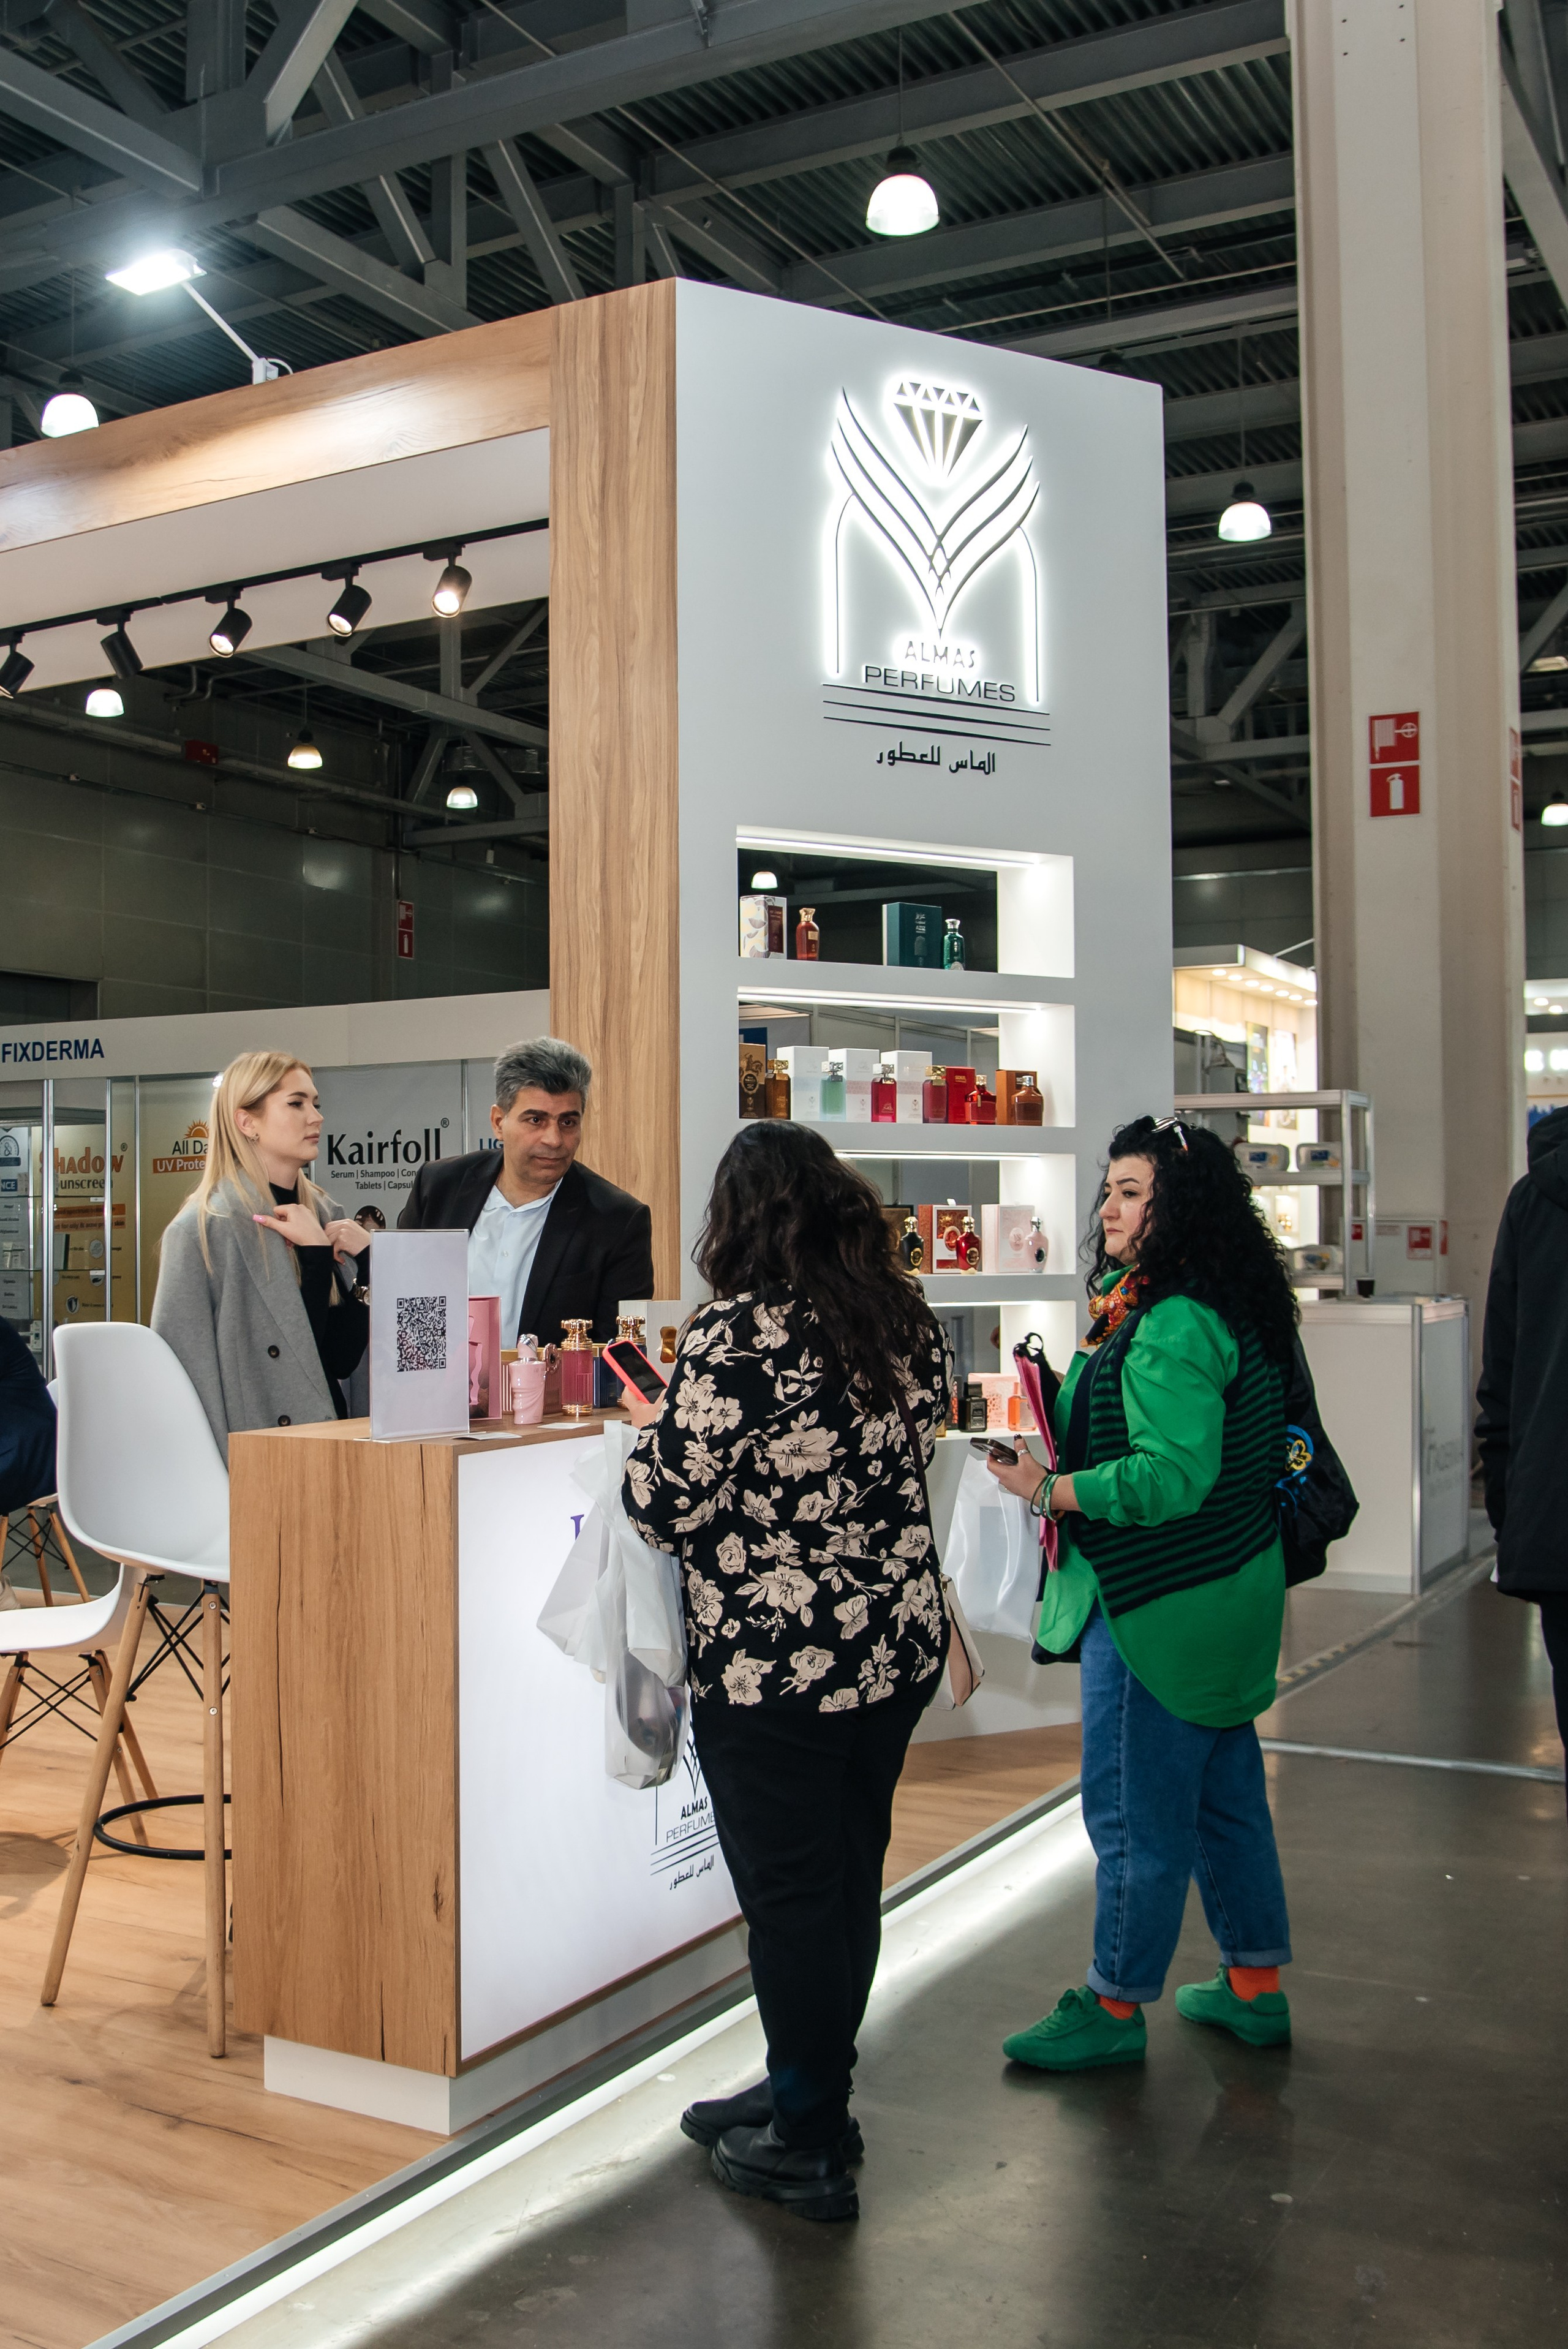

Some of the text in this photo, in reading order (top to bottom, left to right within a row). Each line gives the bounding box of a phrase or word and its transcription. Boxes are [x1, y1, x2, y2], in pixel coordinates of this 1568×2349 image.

[905, 641, 975, 668] ALMAS
[864, 665, 1016, 702] PERFUMES
[876, 741, 995, 775] الماس للعطور
[2, 1038, 105, 1063] FIXDERMA
[172, 1140, 189, 1155] All
[157, 1159, 175, 1172] UV
[360, 1169, 395, 1179] Shampoo
[59, 1178, 113, 1190] unscree
[355, 1181, 382, 1190] Tablets
[680, 1797, 708, 1820] ALMAS
[669, 1854, 714, 1890] الماس للعطور
